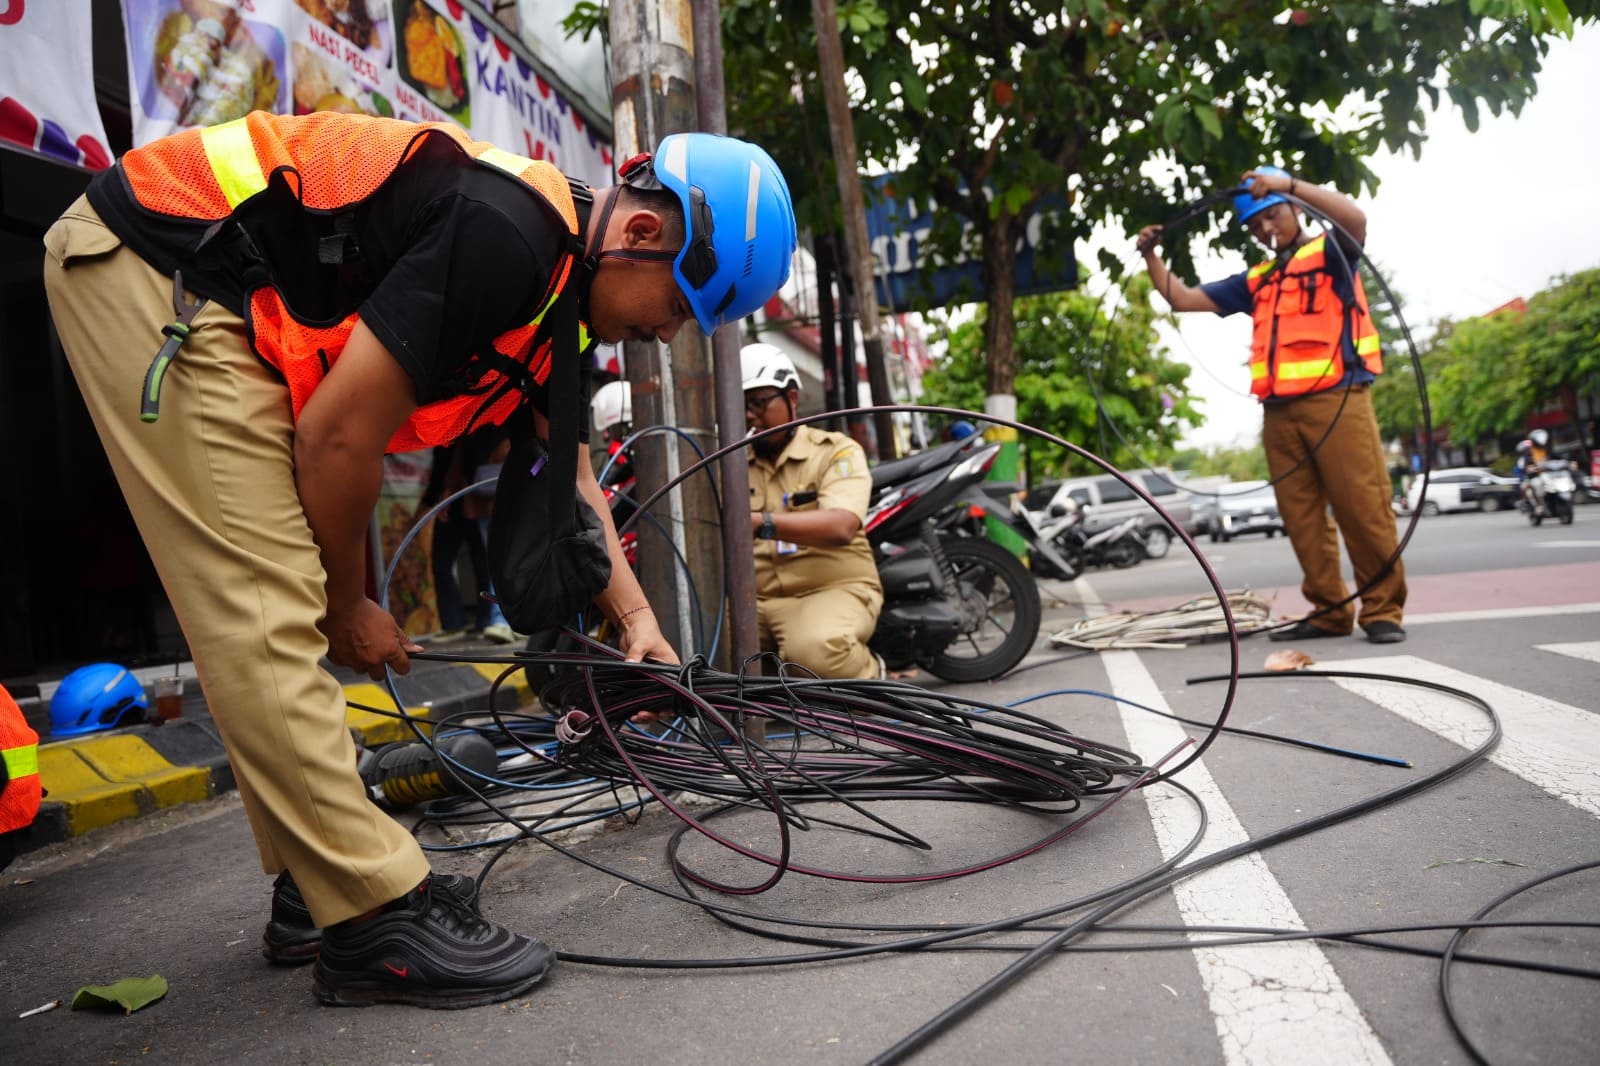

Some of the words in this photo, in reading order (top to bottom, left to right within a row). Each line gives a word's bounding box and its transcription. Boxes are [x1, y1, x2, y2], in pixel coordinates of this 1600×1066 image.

[309, 24, 341, 59] NASI
[345, 47, 381, 85] PECEL
[475, 51, 561, 145] KANTIN
